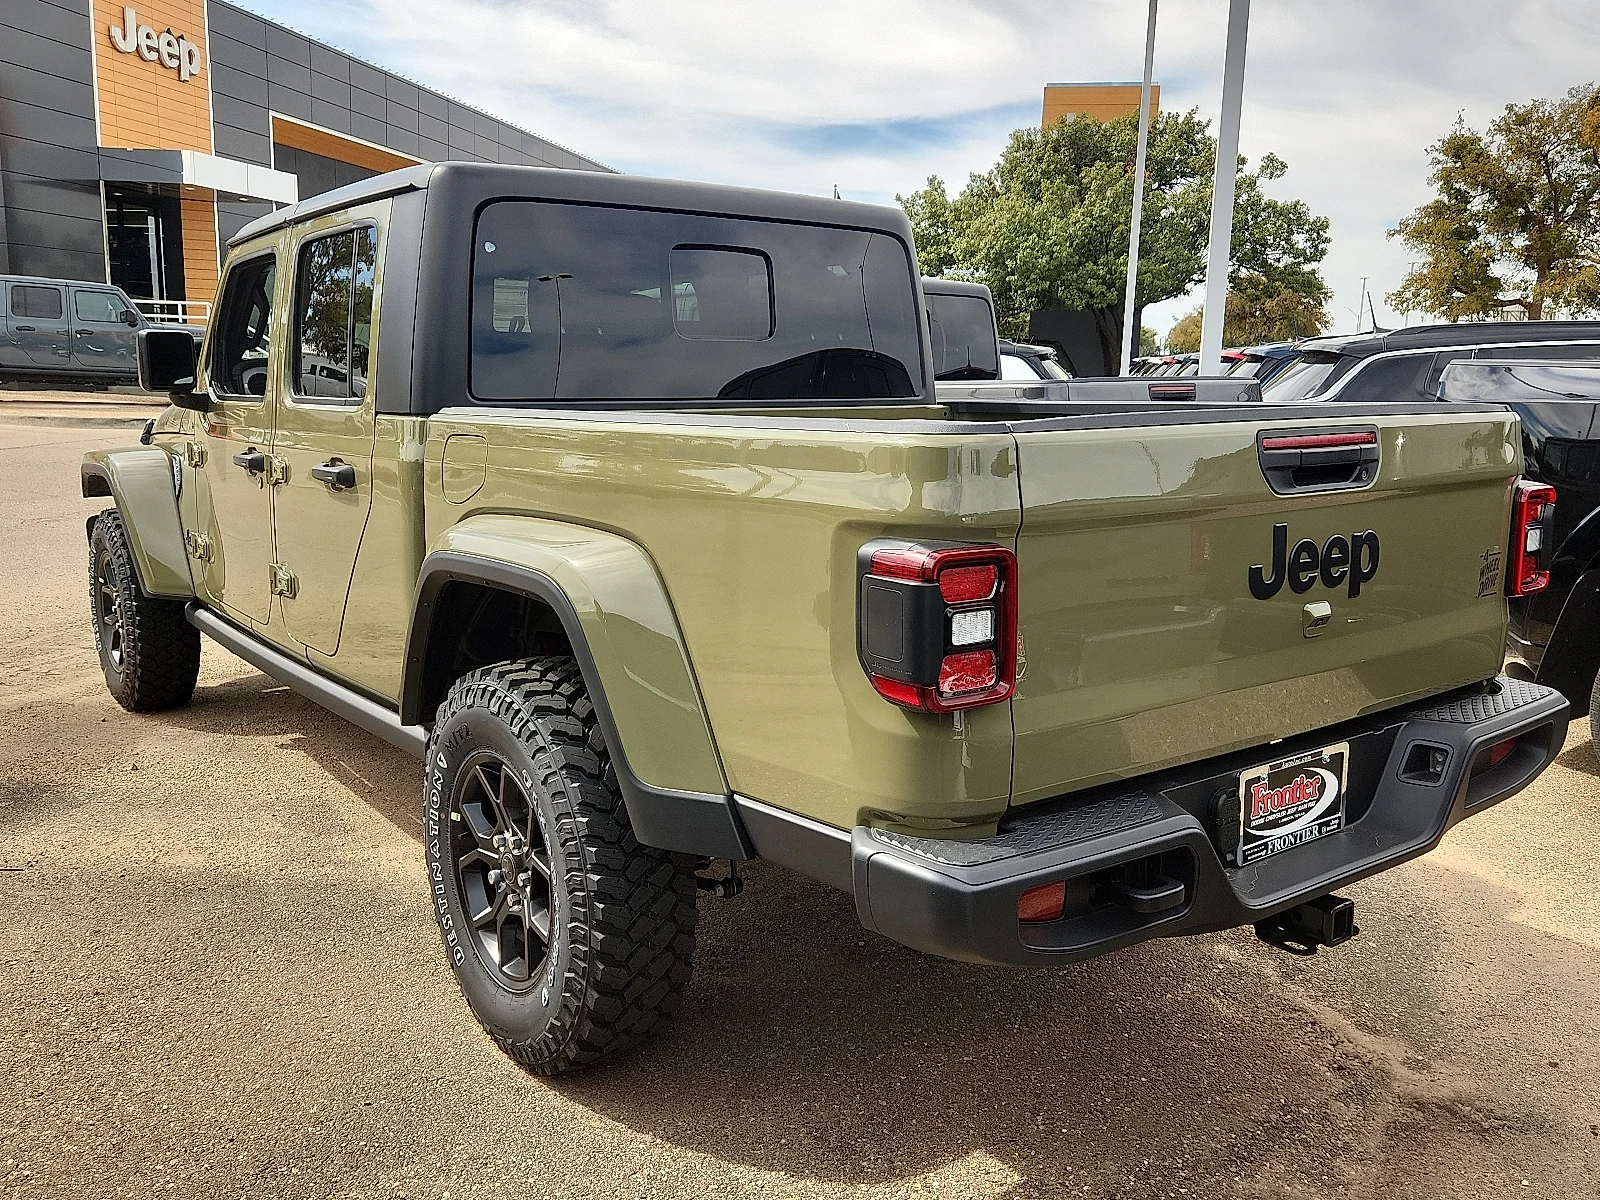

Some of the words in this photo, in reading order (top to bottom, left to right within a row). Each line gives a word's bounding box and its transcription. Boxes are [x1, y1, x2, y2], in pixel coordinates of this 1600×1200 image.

[108, 6, 200, 82] Jeep
[1249, 523, 1380, 600] Jeep
[1479, 557, 1501, 582] WHEEL
[1251, 774, 1321, 819] Frontier
[427, 768, 464, 967] DESTINATION
[1267, 825, 1320, 855] FRONTIER
